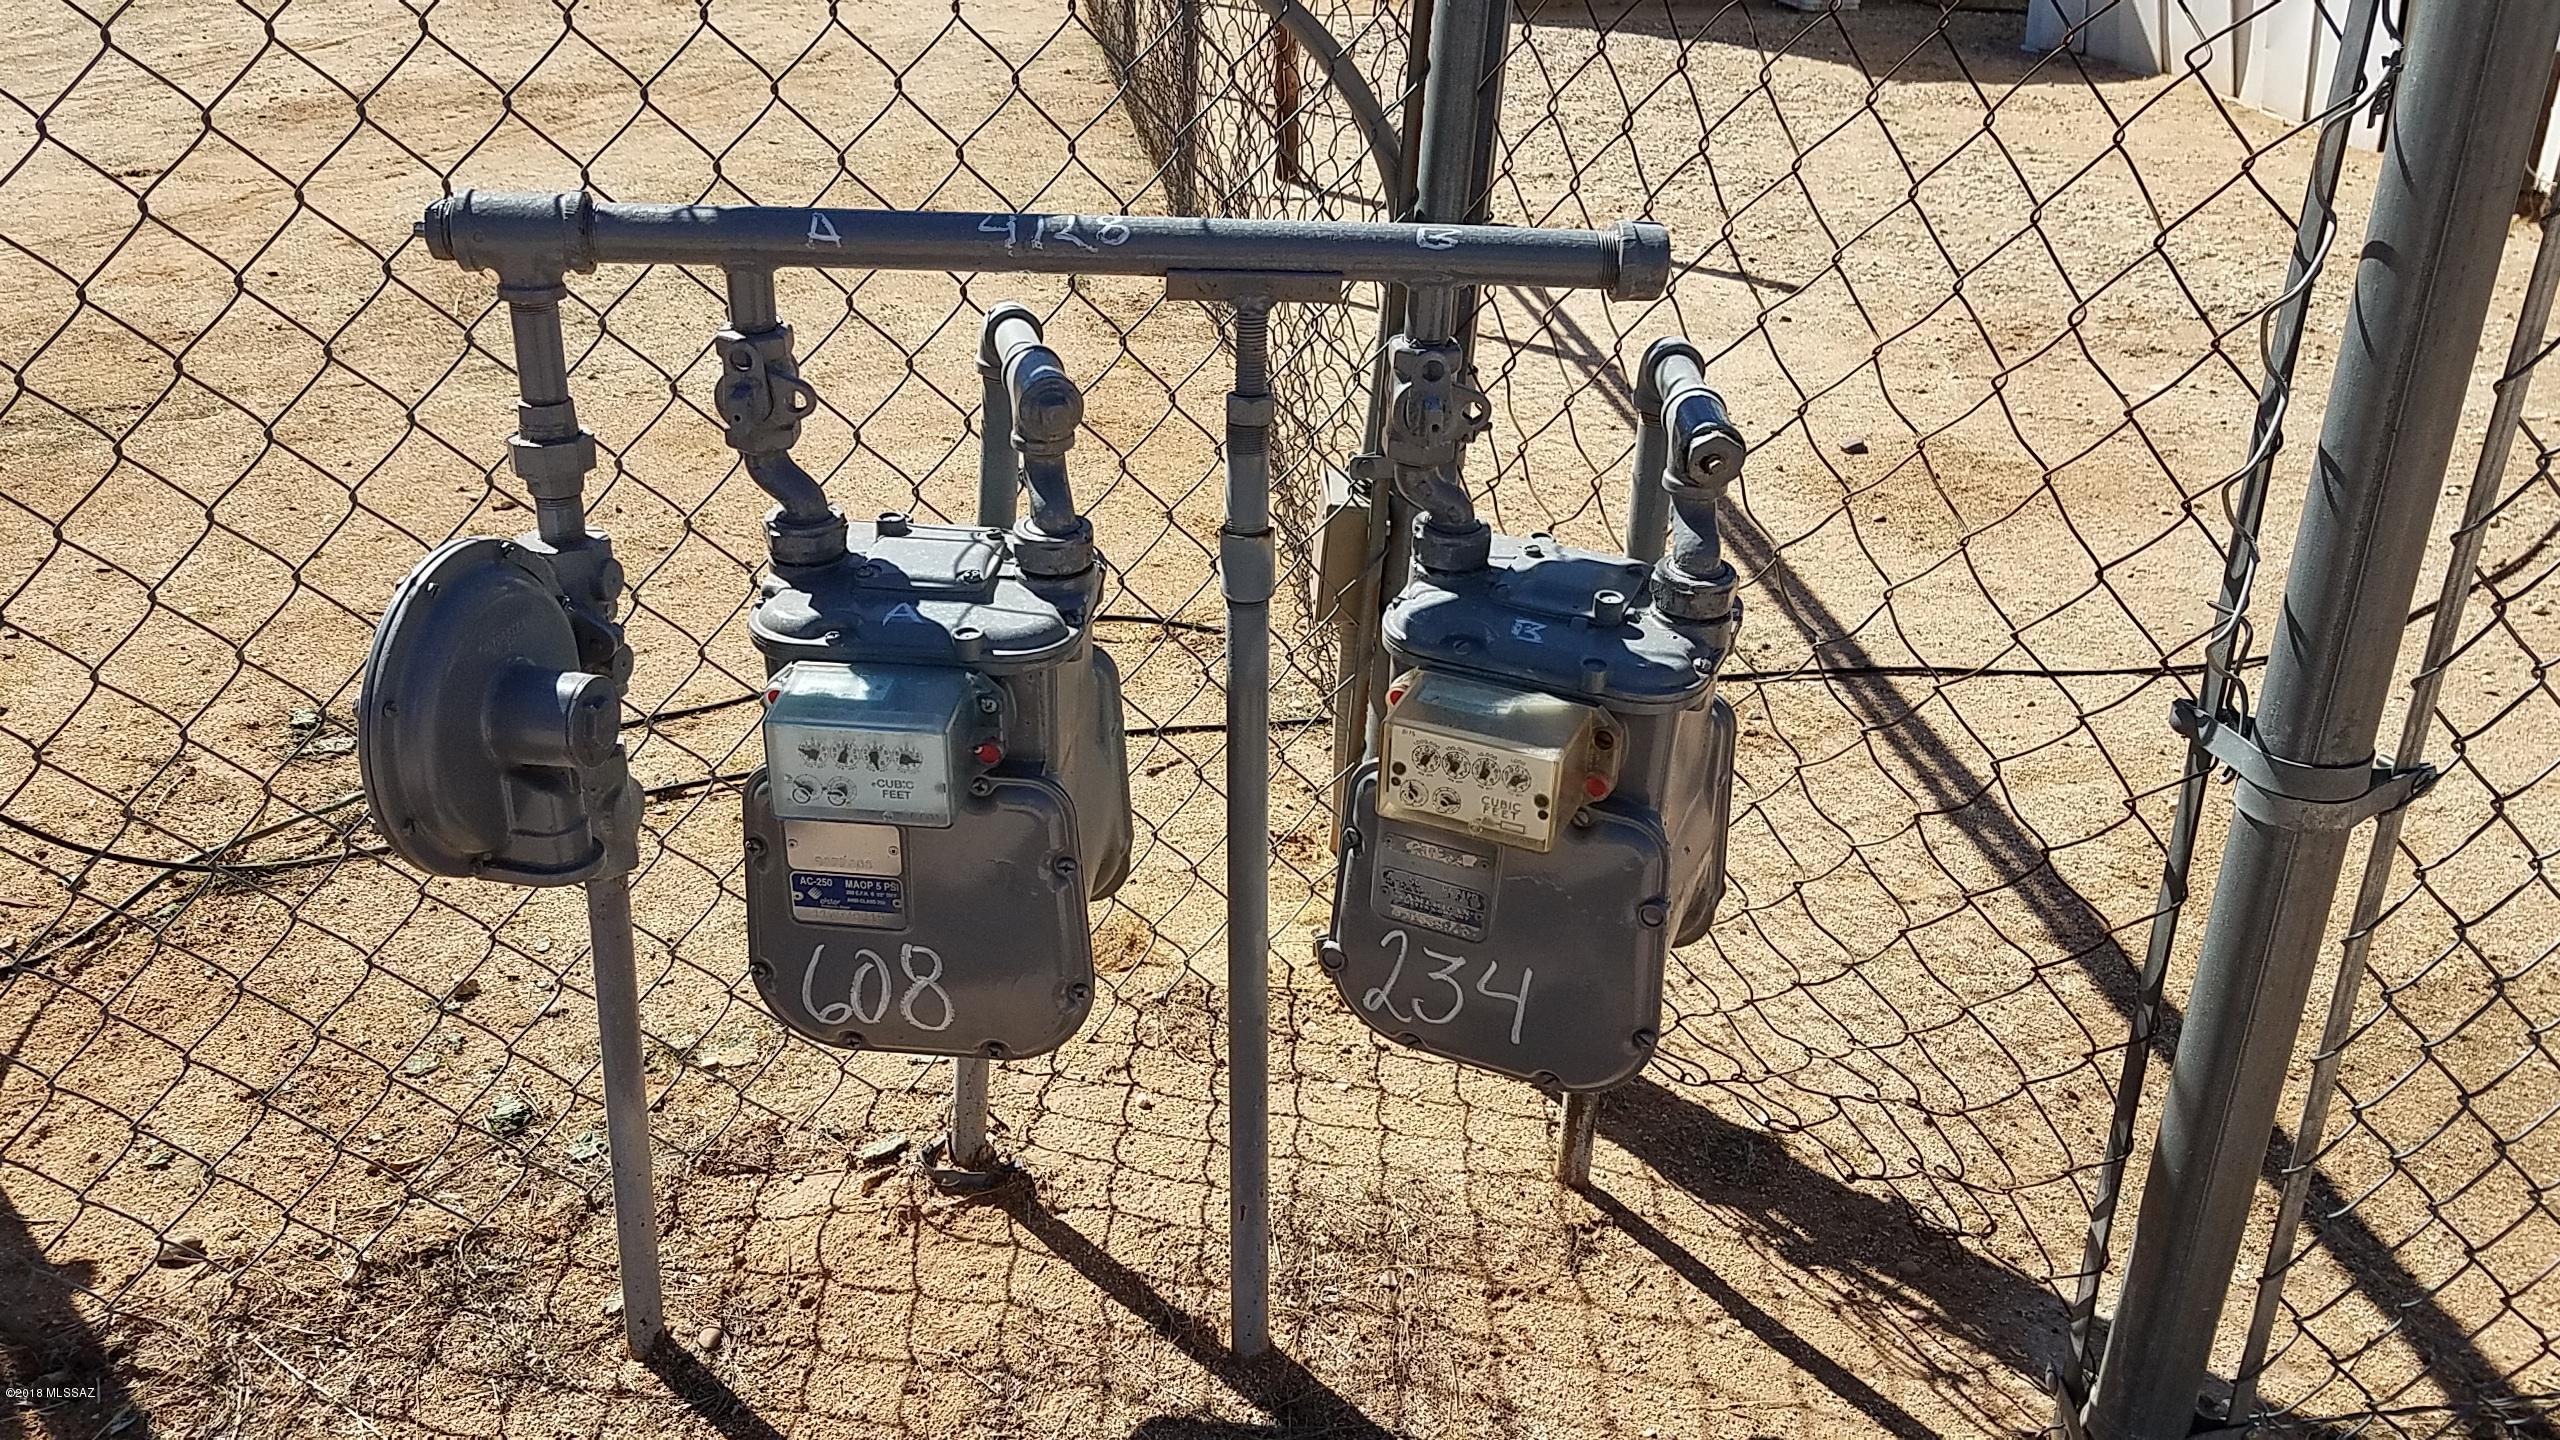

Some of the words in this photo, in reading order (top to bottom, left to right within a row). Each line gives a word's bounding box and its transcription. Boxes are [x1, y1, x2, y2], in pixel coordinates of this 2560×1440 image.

[806, 212, 842, 249] A
[978, 214, 1131, 256] 4128
[1416, 226, 1463, 251] B
[882, 602, 925, 627] A
[1511, 618, 1548, 644] B
[882, 789, 912, 800] FEET
[1481, 795, 1521, 812] CUBIC
[1482, 804, 1519, 821] FEET
[799, 876, 833, 887] AC-250
[845, 879, 873, 890] MAOP
[876, 881, 882, 891] 5
[883, 882, 899, 892] PSI
[802, 943, 956, 1032] 608
[1362, 929, 1534, 1045] 234
